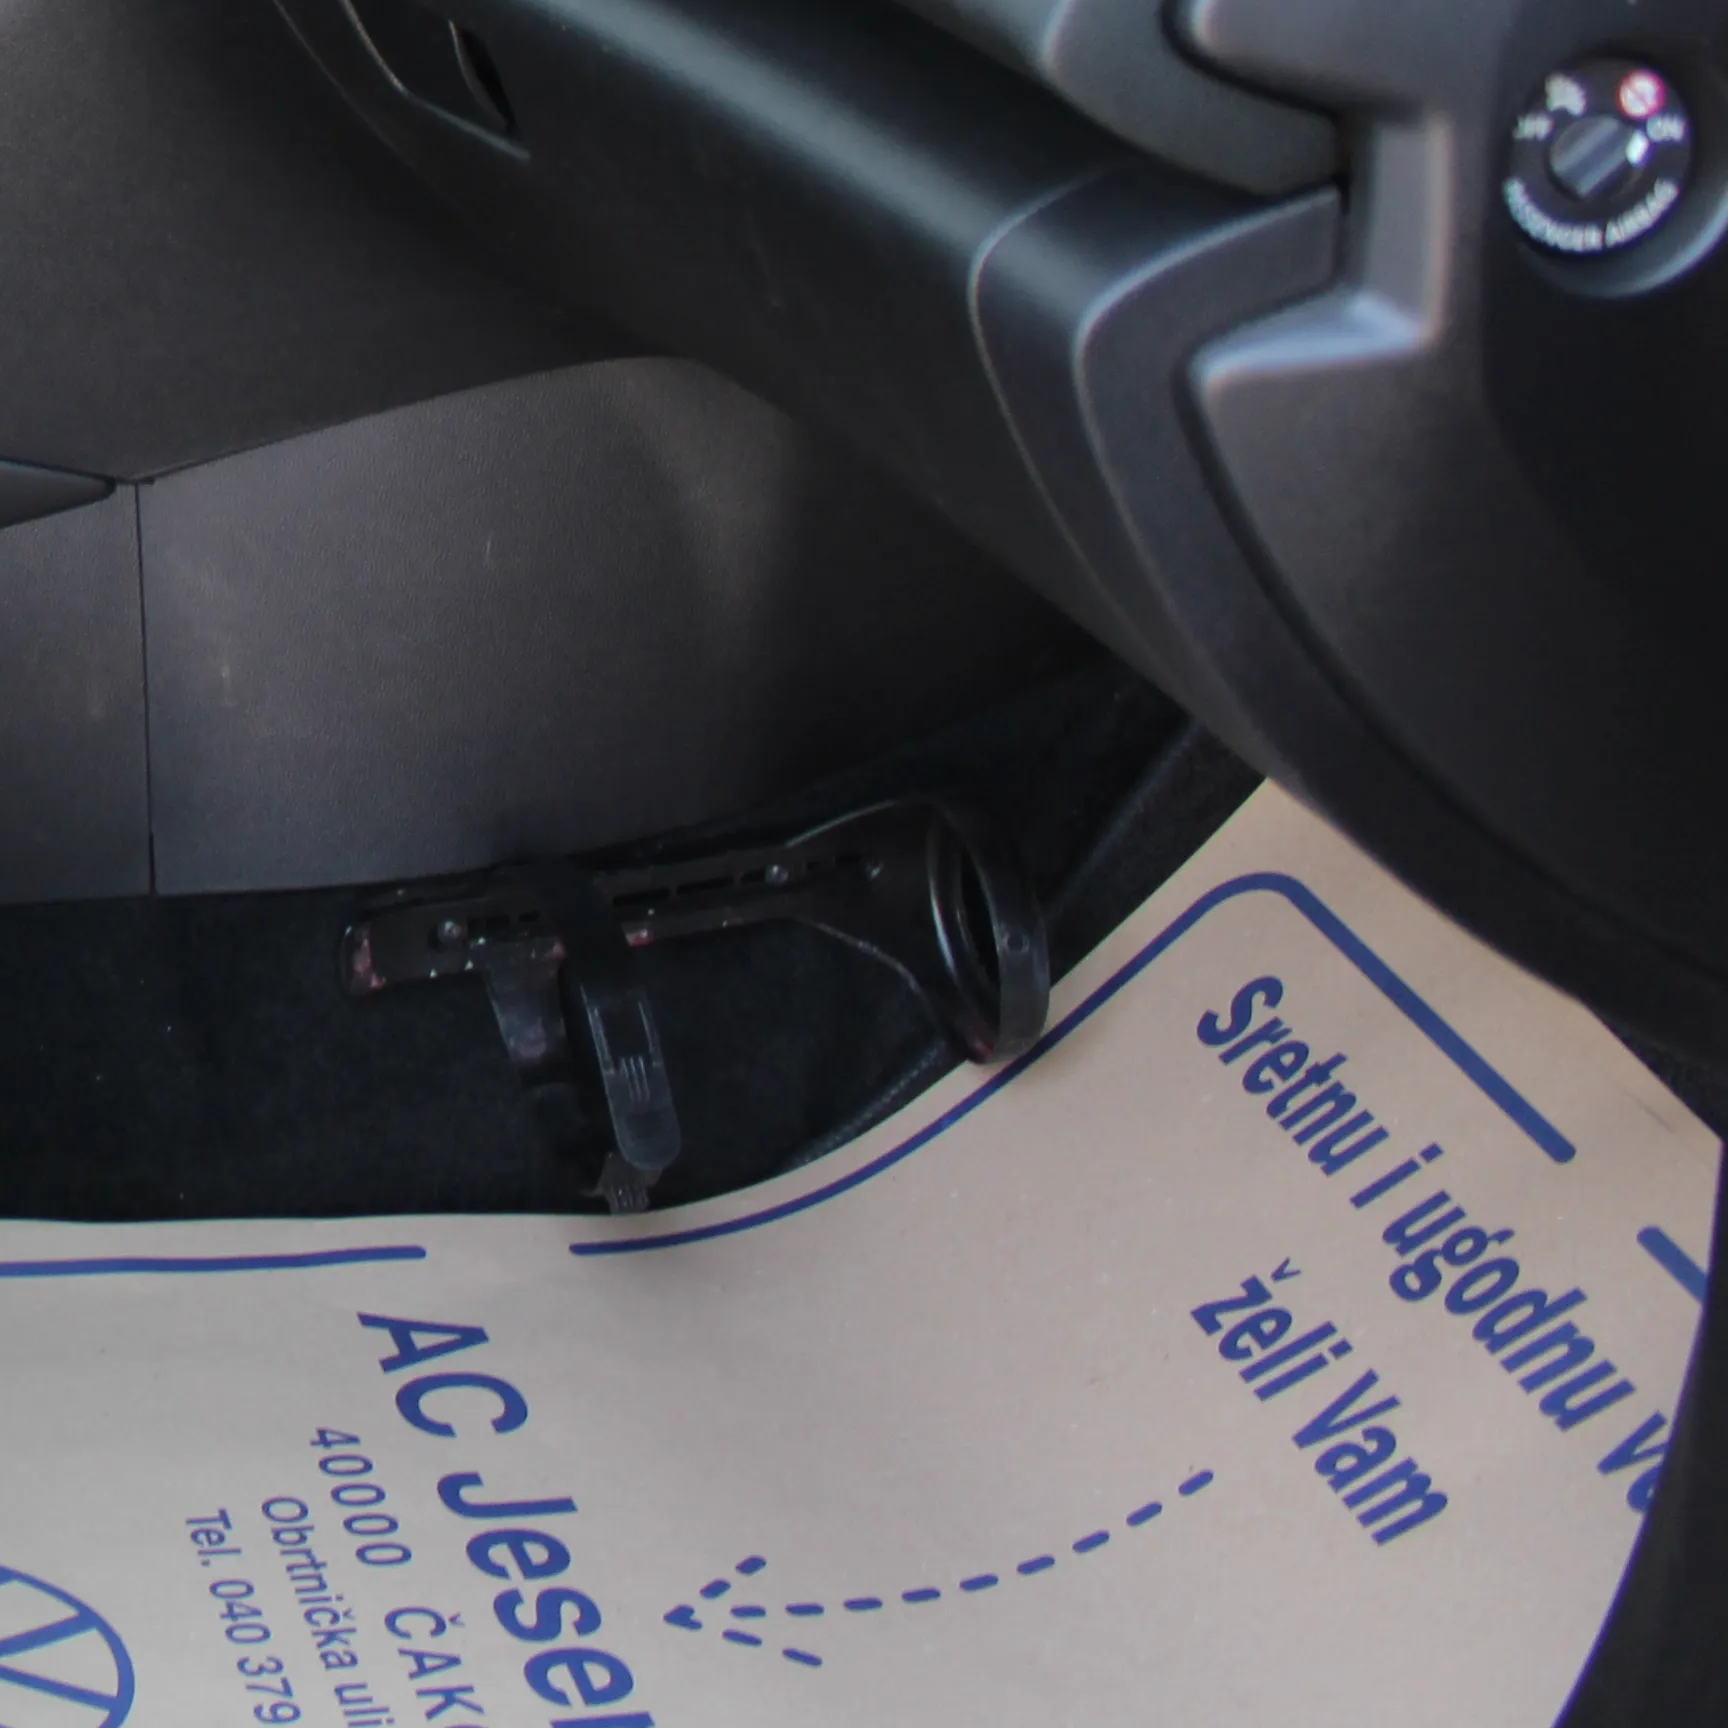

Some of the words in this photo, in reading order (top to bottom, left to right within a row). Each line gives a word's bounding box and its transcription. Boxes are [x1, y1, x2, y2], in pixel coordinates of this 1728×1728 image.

[1196, 975, 1390, 1176] Sretnu
[1349, 1142, 1444, 1209] i
[356, 1311, 529, 1438] AC
[1382, 1189, 1636, 1432] ugodnu
[1190, 1256, 1353, 1402] želi
[1291, 1368, 1448, 1547] Vam
[185, 1507, 242, 1568] Tel.
[208, 1578, 272, 1645] 040
[261, 1495, 359, 1672] Obrtnička
[309, 1426, 413, 1567] 40000
[383, 1605, 490, 1728] ČAK
[236, 1655, 301, 1725] 379
